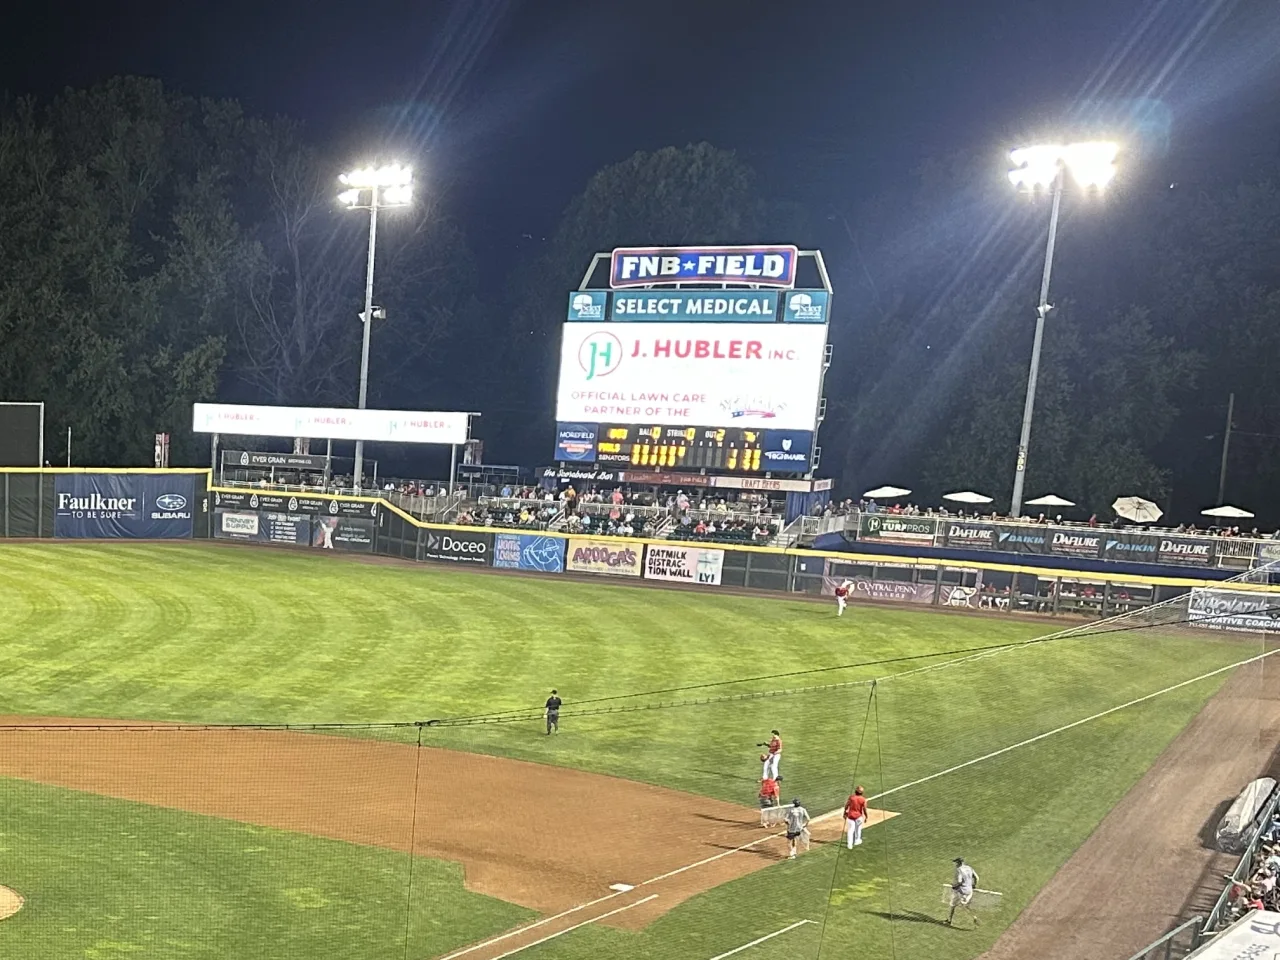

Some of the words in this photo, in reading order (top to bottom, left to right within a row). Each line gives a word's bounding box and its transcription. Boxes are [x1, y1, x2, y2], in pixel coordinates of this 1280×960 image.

[622, 256, 680, 279] FNB
[696, 254, 786, 278] FIELD
[616, 298, 682, 314] SELECT
[686, 298, 772, 315] MEDICAL
[631, 340, 647, 358] J.
[654, 340, 762, 359] HUBLER
[768, 350, 800, 360] INC.
[571, 391, 626, 401] OFFICIAL
[631, 393, 669, 402] LAWN
[672, 394, 706, 403] CARE
[584, 406, 641, 416] PARTNER
[645, 407, 661, 416] OF
[666, 408, 691, 417] THE
[314, 417, 346, 425] HUBLER
[410, 421, 445, 429] HUBLER
[560, 431, 594, 439] MOREFIELD
[252, 456, 267, 464] EVER
[268, 456, 286, 464] GRAIN
[544, 469, 555, 477] the
[57, 493, 136, 510] Faulkner
[100, 511, 121, 519] SURE
[949, 525, 994, 539] DAFLURE
[442, 536, 487, 553] Doceo
[1008, 533, 1046, 544] DAIKIN
[1052, 532, 1101, 547] DAFLURE
[1115, 541, 1157, 553] DAIKIN
[1160, 540, 1211, 555] DAFLURE
[650, 548, 687, 560] OATMILK
[649, 558, 686, 568] DISTRAC-
[648, 566, 667, 576] TION
[857, 581, 894, 593] CENTRAL
[895, 584, 919, 595] PENN
